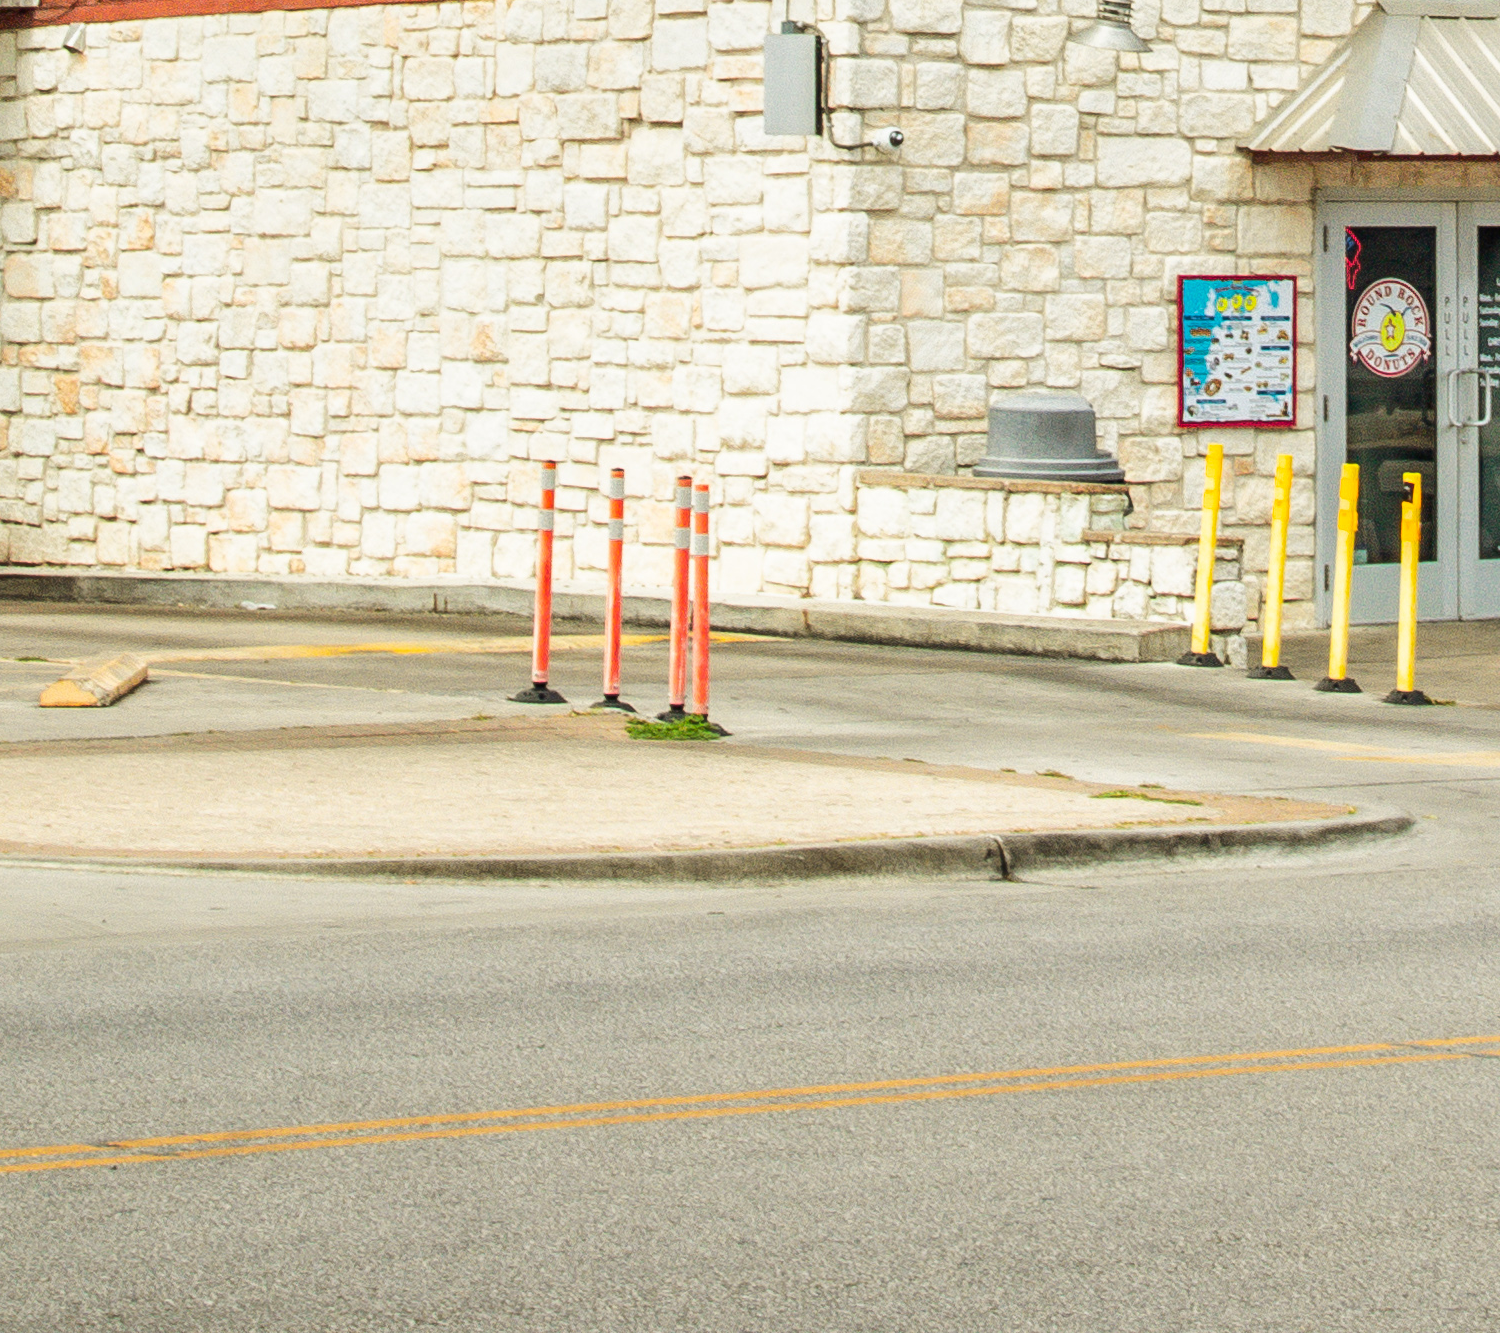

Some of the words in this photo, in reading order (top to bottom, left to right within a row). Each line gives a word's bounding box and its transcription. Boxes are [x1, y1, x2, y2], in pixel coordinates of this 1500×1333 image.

[1357, 285, 1392, 328] ROUND
[1396, 287, 1424, 327] ROCK
[1365, 347, 1417, 371] DONUTS
